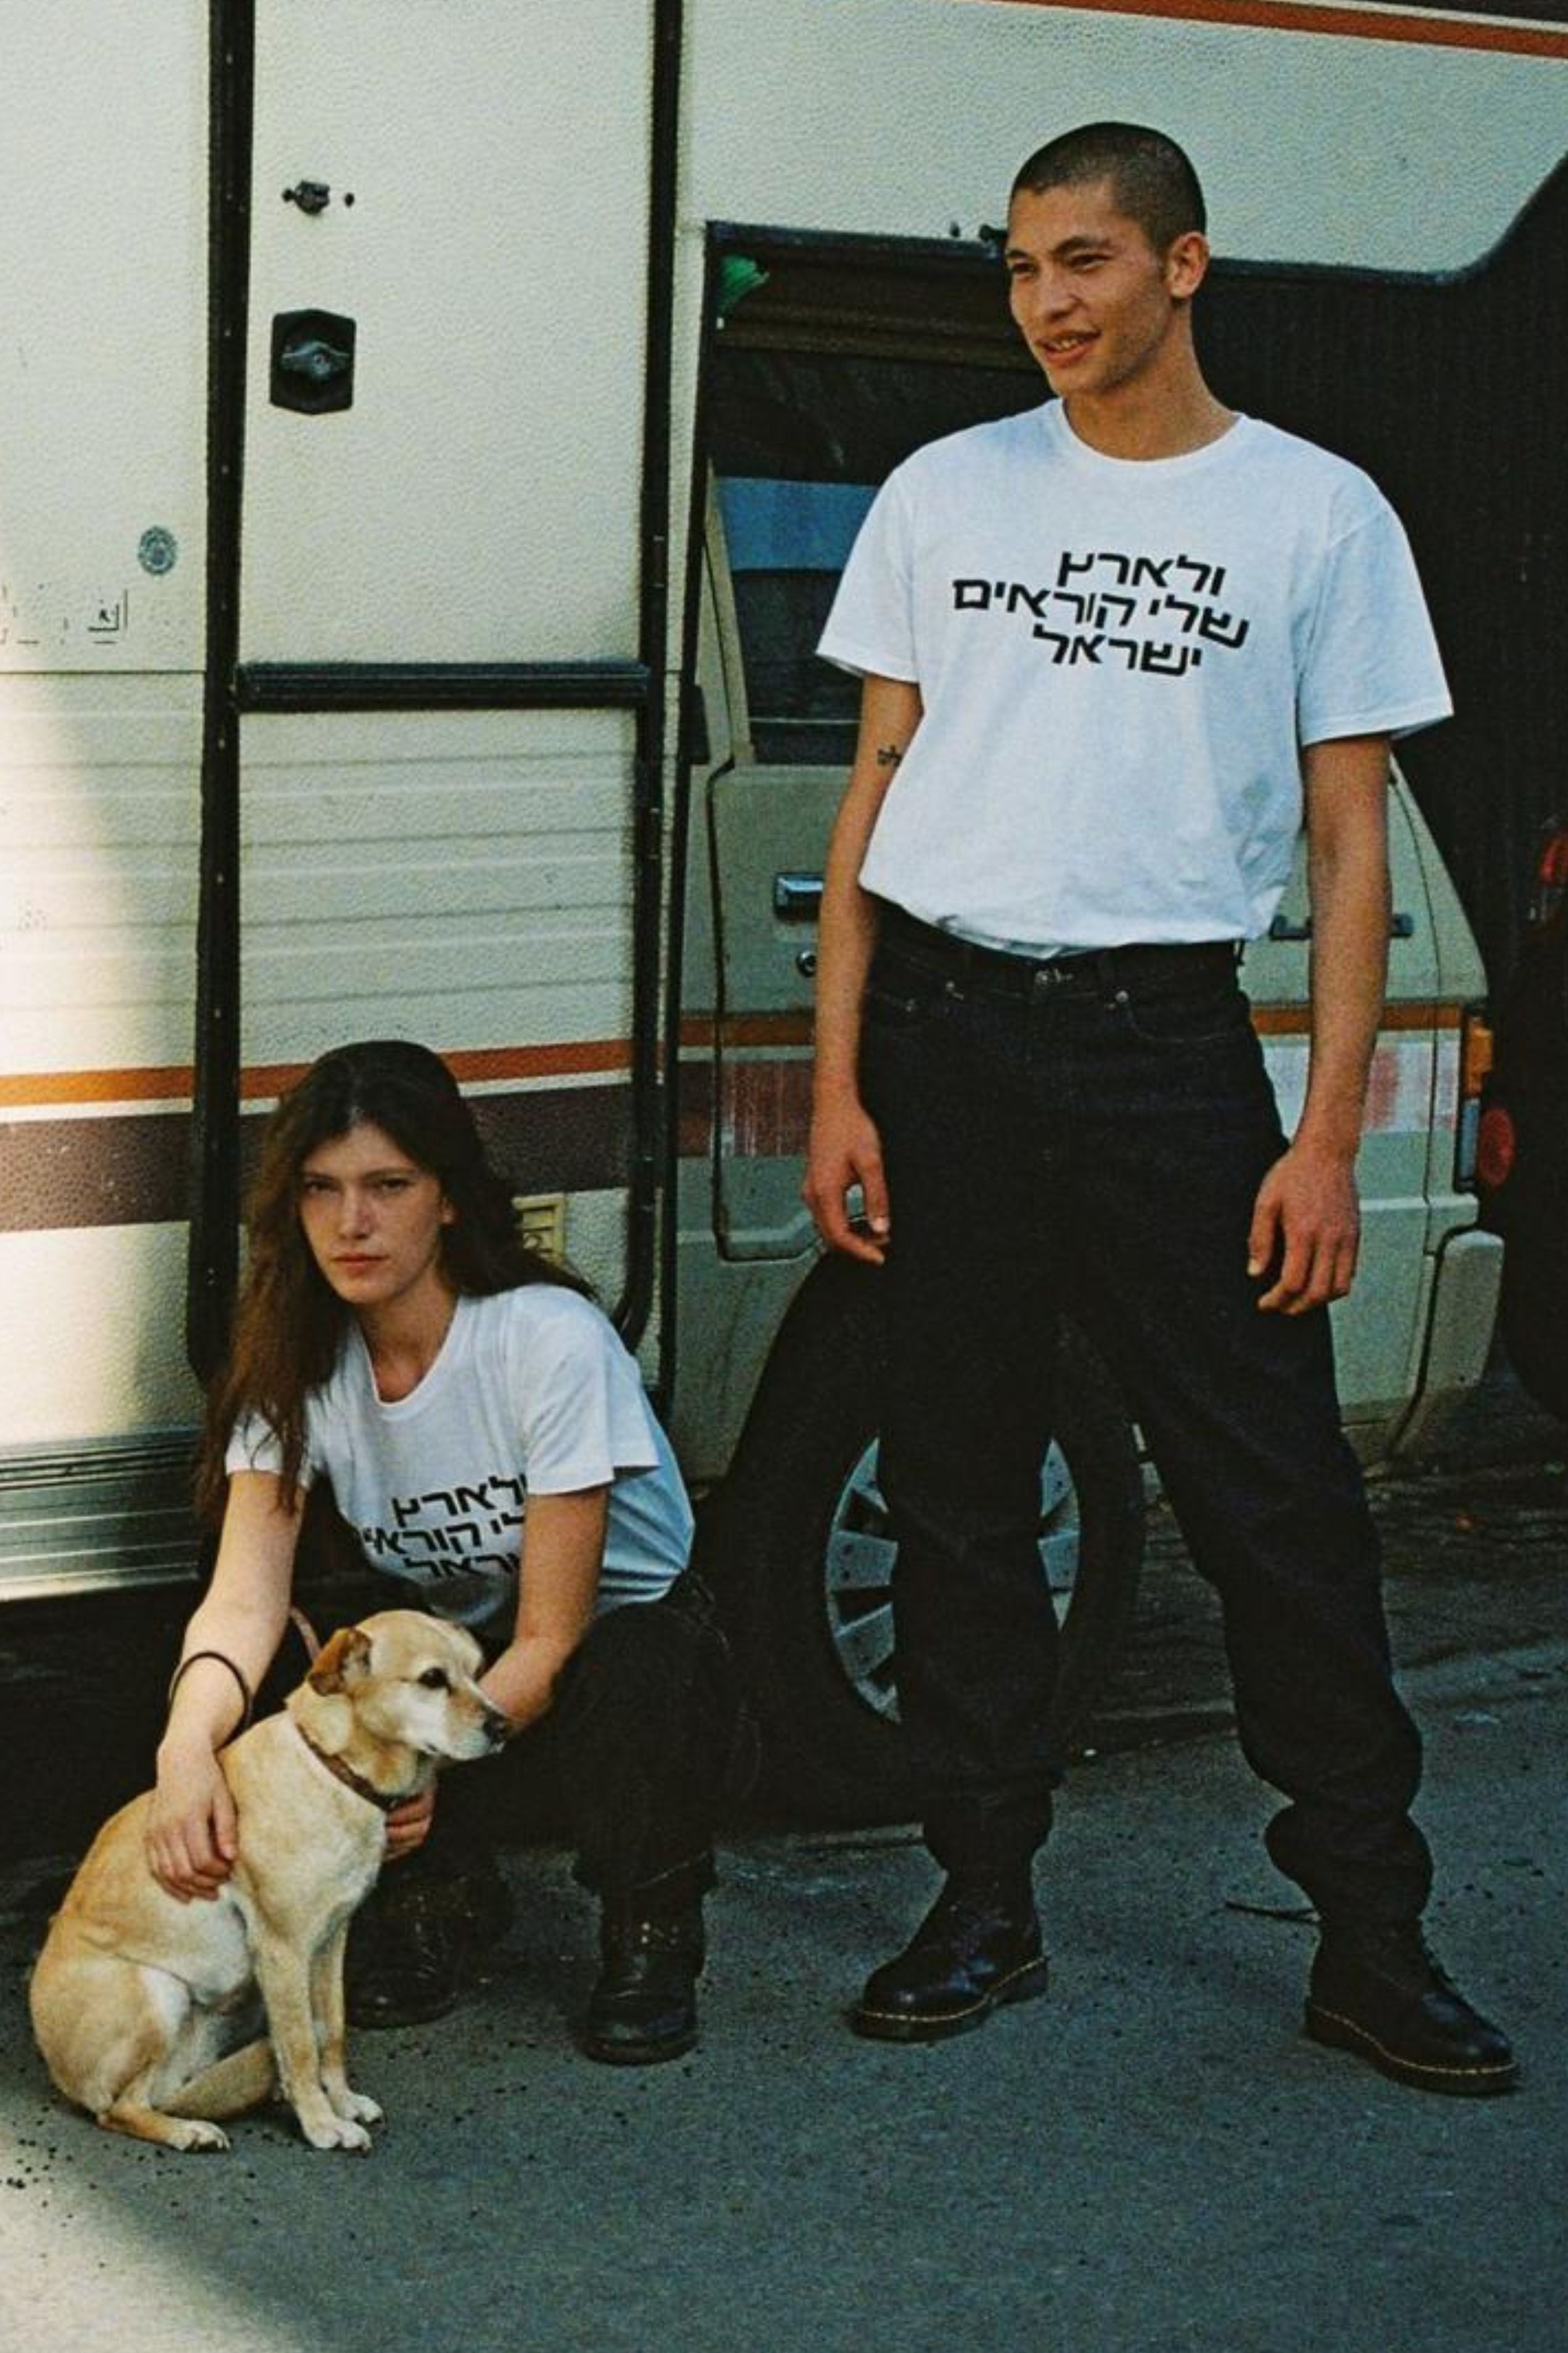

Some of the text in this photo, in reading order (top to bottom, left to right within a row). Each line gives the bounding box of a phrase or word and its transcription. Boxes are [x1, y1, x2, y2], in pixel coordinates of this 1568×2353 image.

[1057, 552, 1225, 596] ולארץ
[952, 579, 1249, 648] שלי קוראים
[1033, 624, 1202, 677] ישראל
